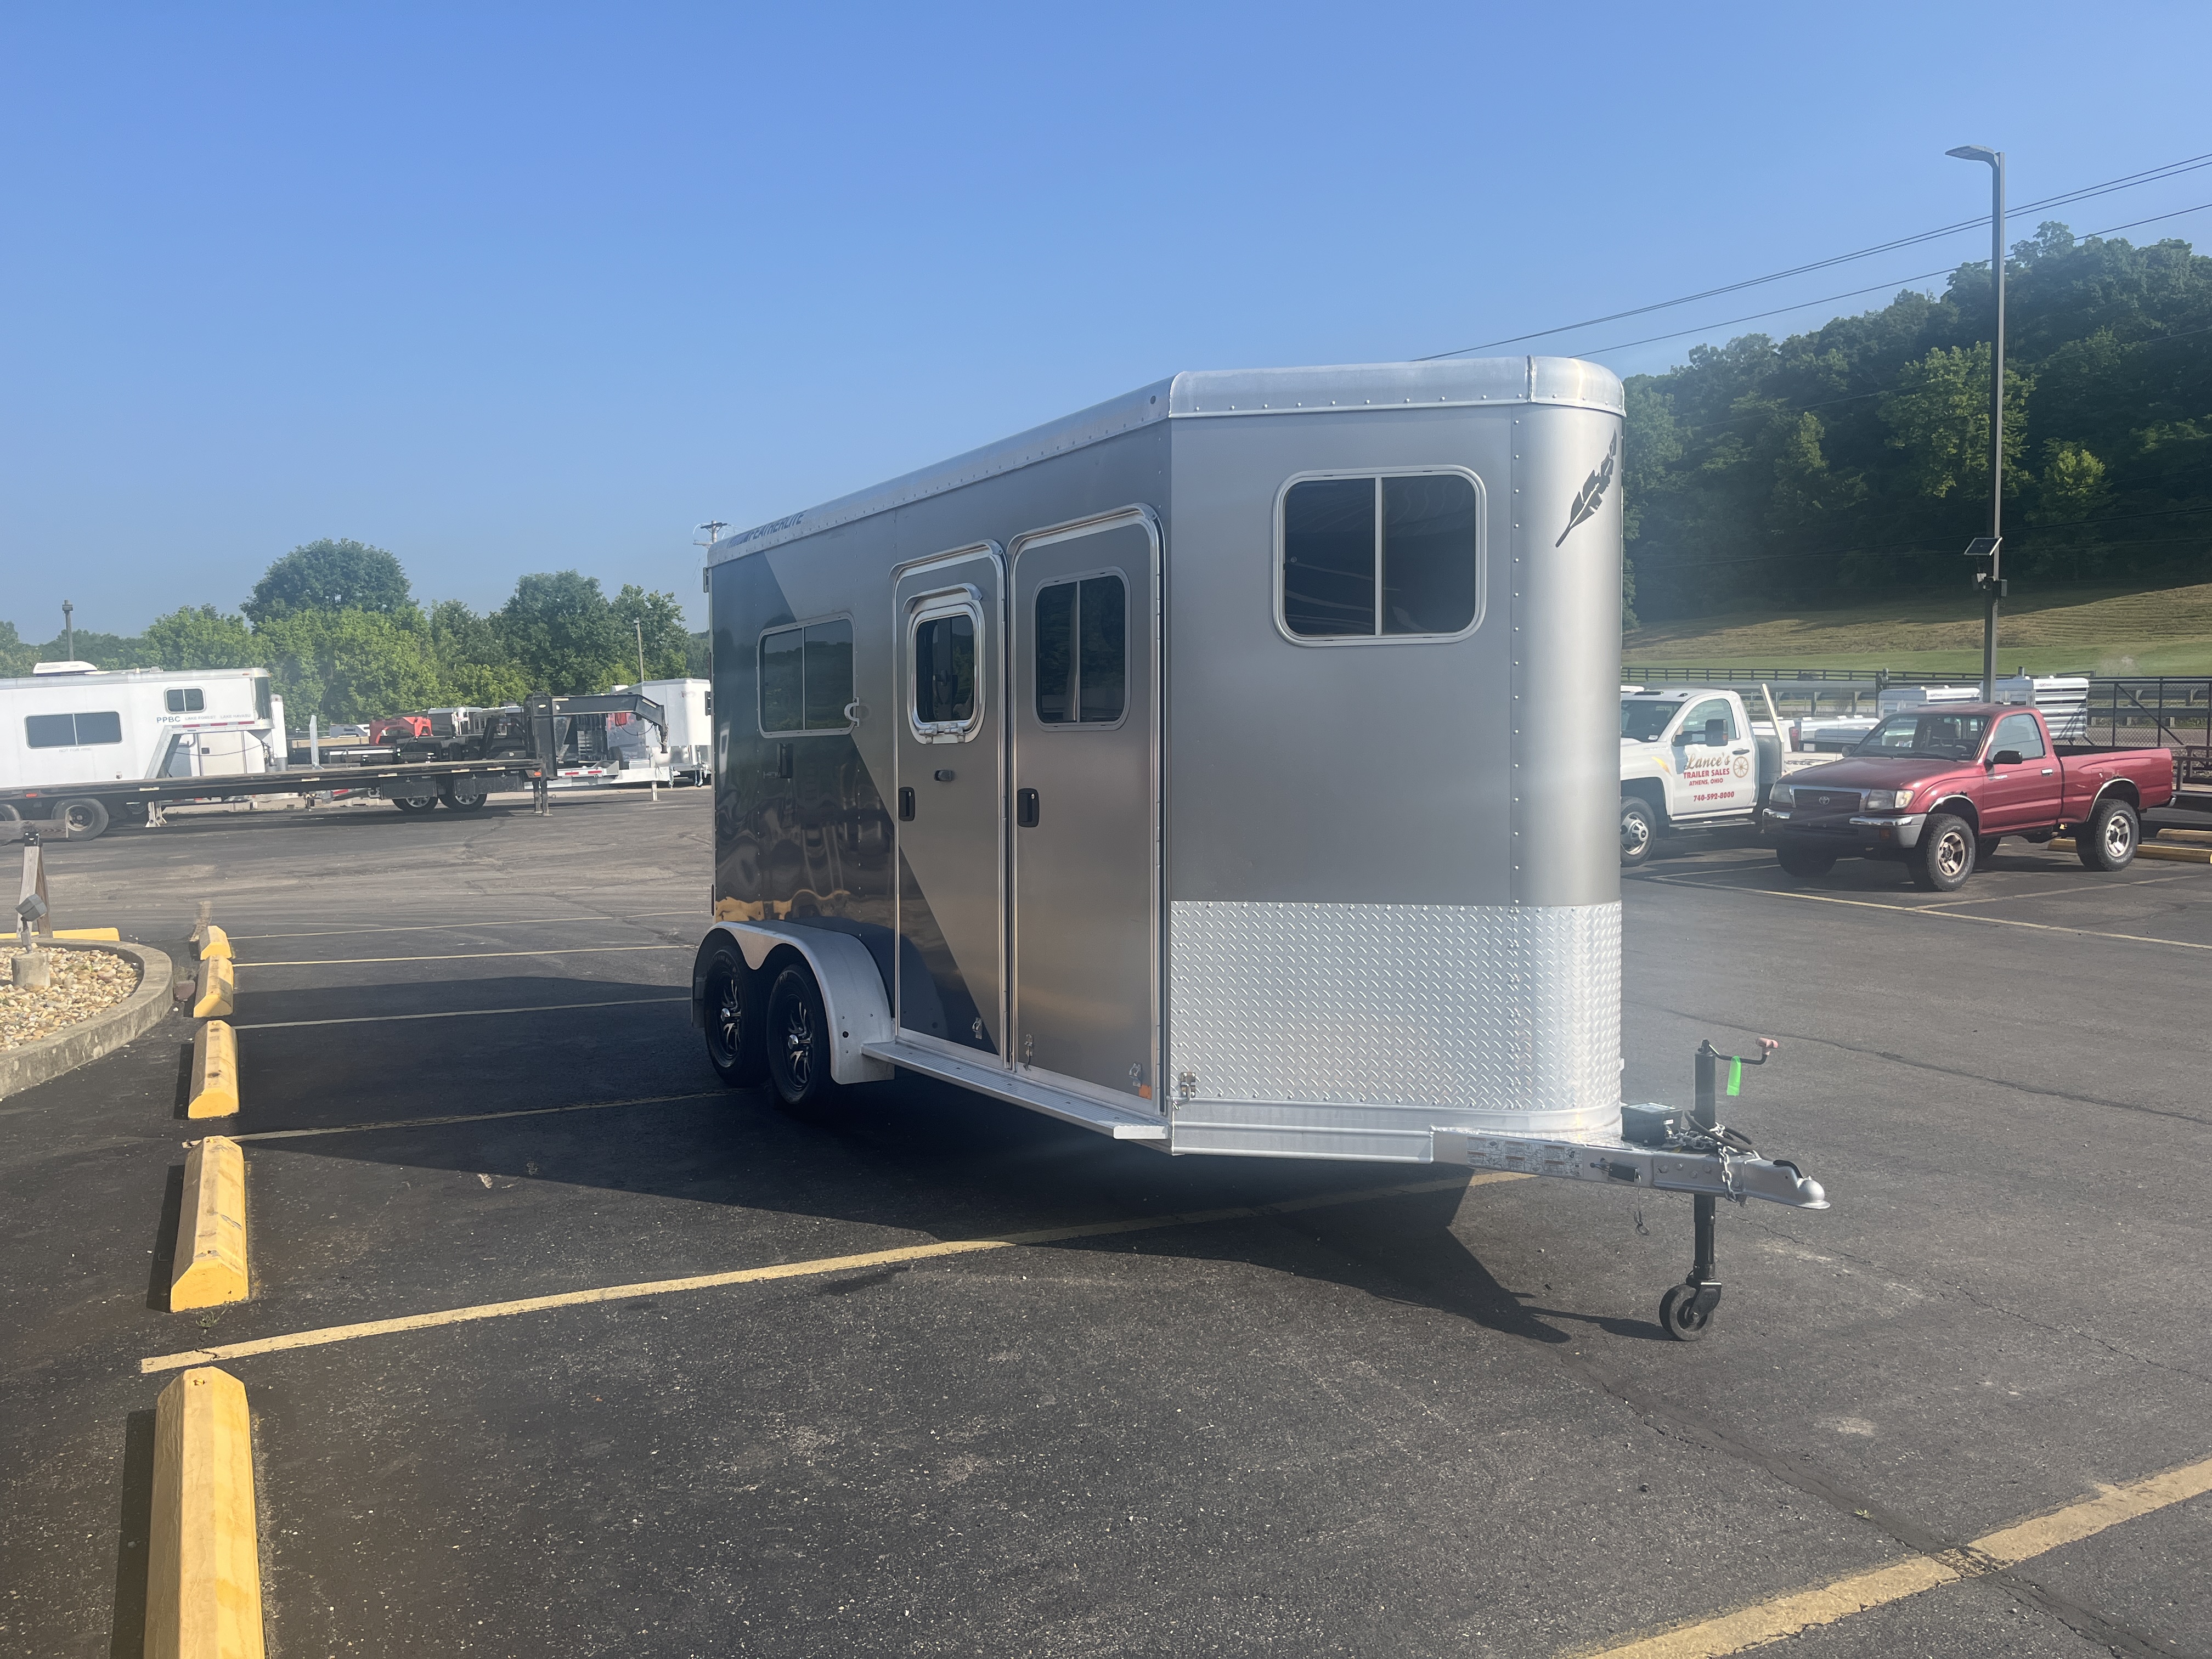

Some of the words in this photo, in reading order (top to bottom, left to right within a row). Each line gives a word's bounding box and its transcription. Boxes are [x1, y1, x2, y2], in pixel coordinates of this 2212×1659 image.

[748, 510, 808, 541] FEATHERLITE
[1683, 752, 1730, 770] Lance's
[1683, 770, 1709, 779] TRAILER
[1711, 768, 1730, 777] SALES
[1693, 791, 1735, 802] 740-592-8000
